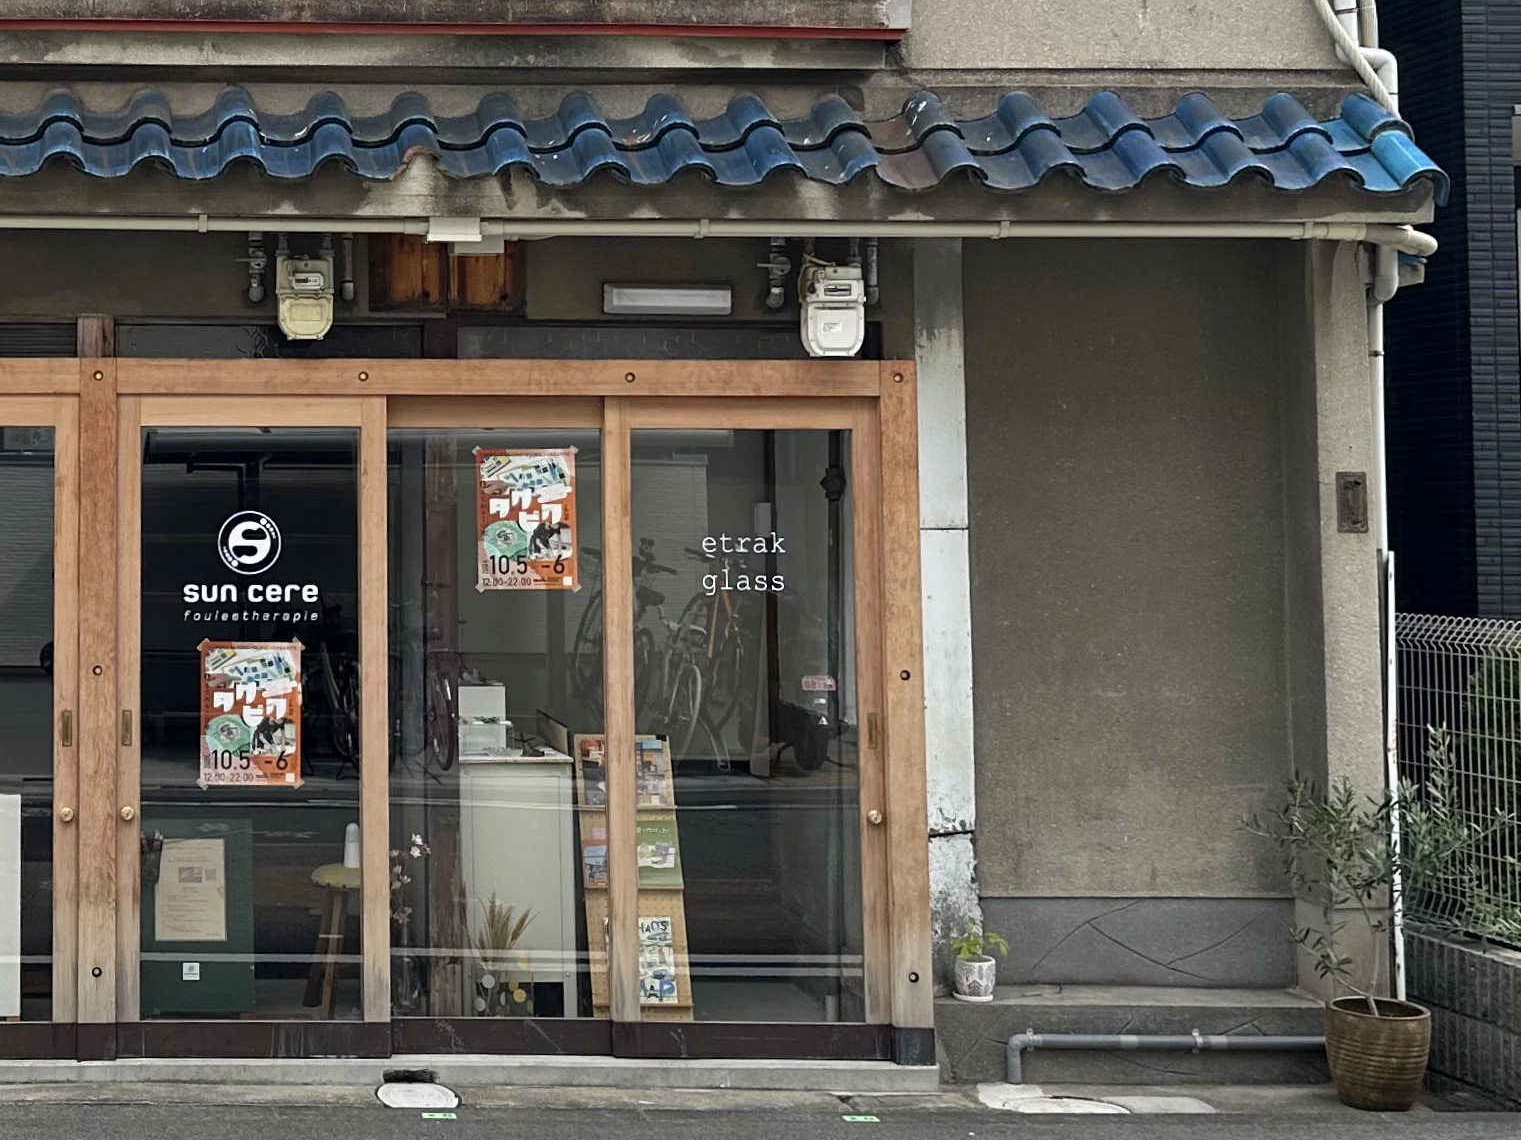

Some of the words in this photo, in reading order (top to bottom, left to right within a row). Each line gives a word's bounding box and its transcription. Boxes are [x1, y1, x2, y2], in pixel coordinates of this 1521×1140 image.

[702, 531, 786, 553] etrak
[489, 555, 528, 574] 10.5
[702, 568, 785, 596] glass
[183, 584, 238, 603] sun
[247, 584, 319, 603] cere
[212, 750, 250, 770] 10.5
